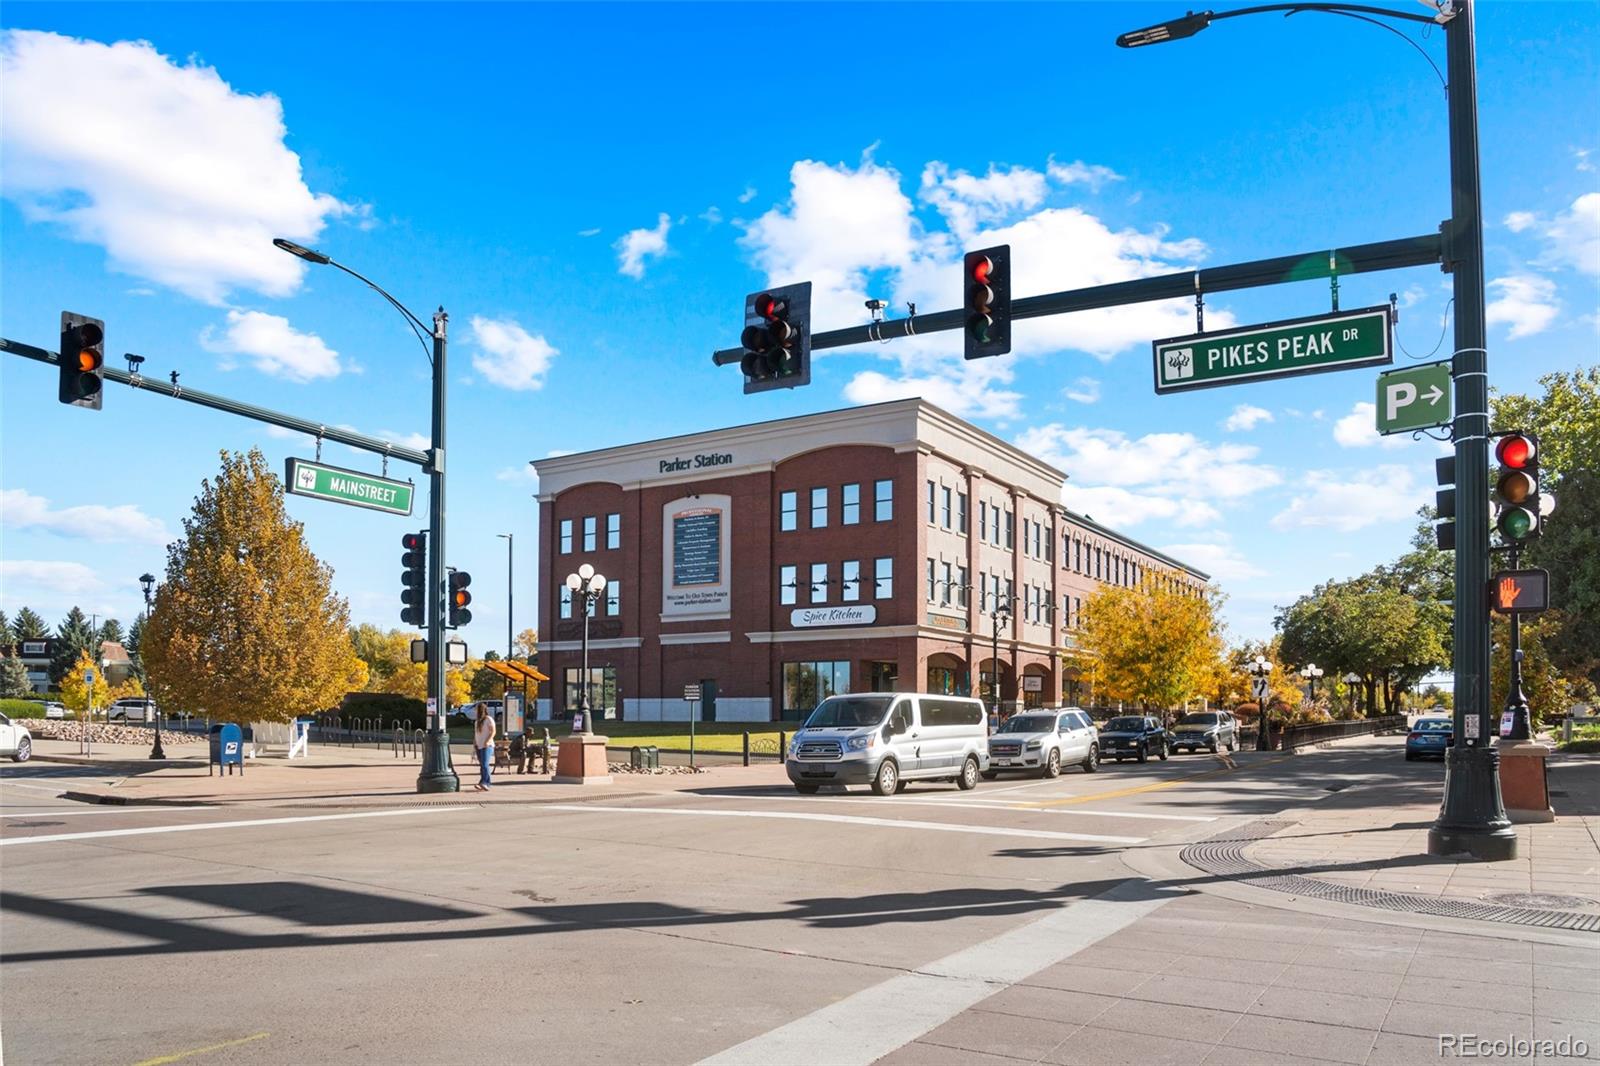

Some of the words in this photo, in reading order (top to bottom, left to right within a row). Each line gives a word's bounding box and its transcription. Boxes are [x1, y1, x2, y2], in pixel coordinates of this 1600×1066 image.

[1208, 341, 1269, 370] PIKES
[1278, 331, 1334, 360] PEAK
[1342, 328, 1358, 342] DR
[1386, 382, 1417, 421] P
[659, 457, 692, 473] Parker
[694, 453, 733, 468] Station
[329, 477, 397, 504] MAINSTREET
[803, 610, 827, 624] Spice
[829, 607, 863, 621] Kitchen
